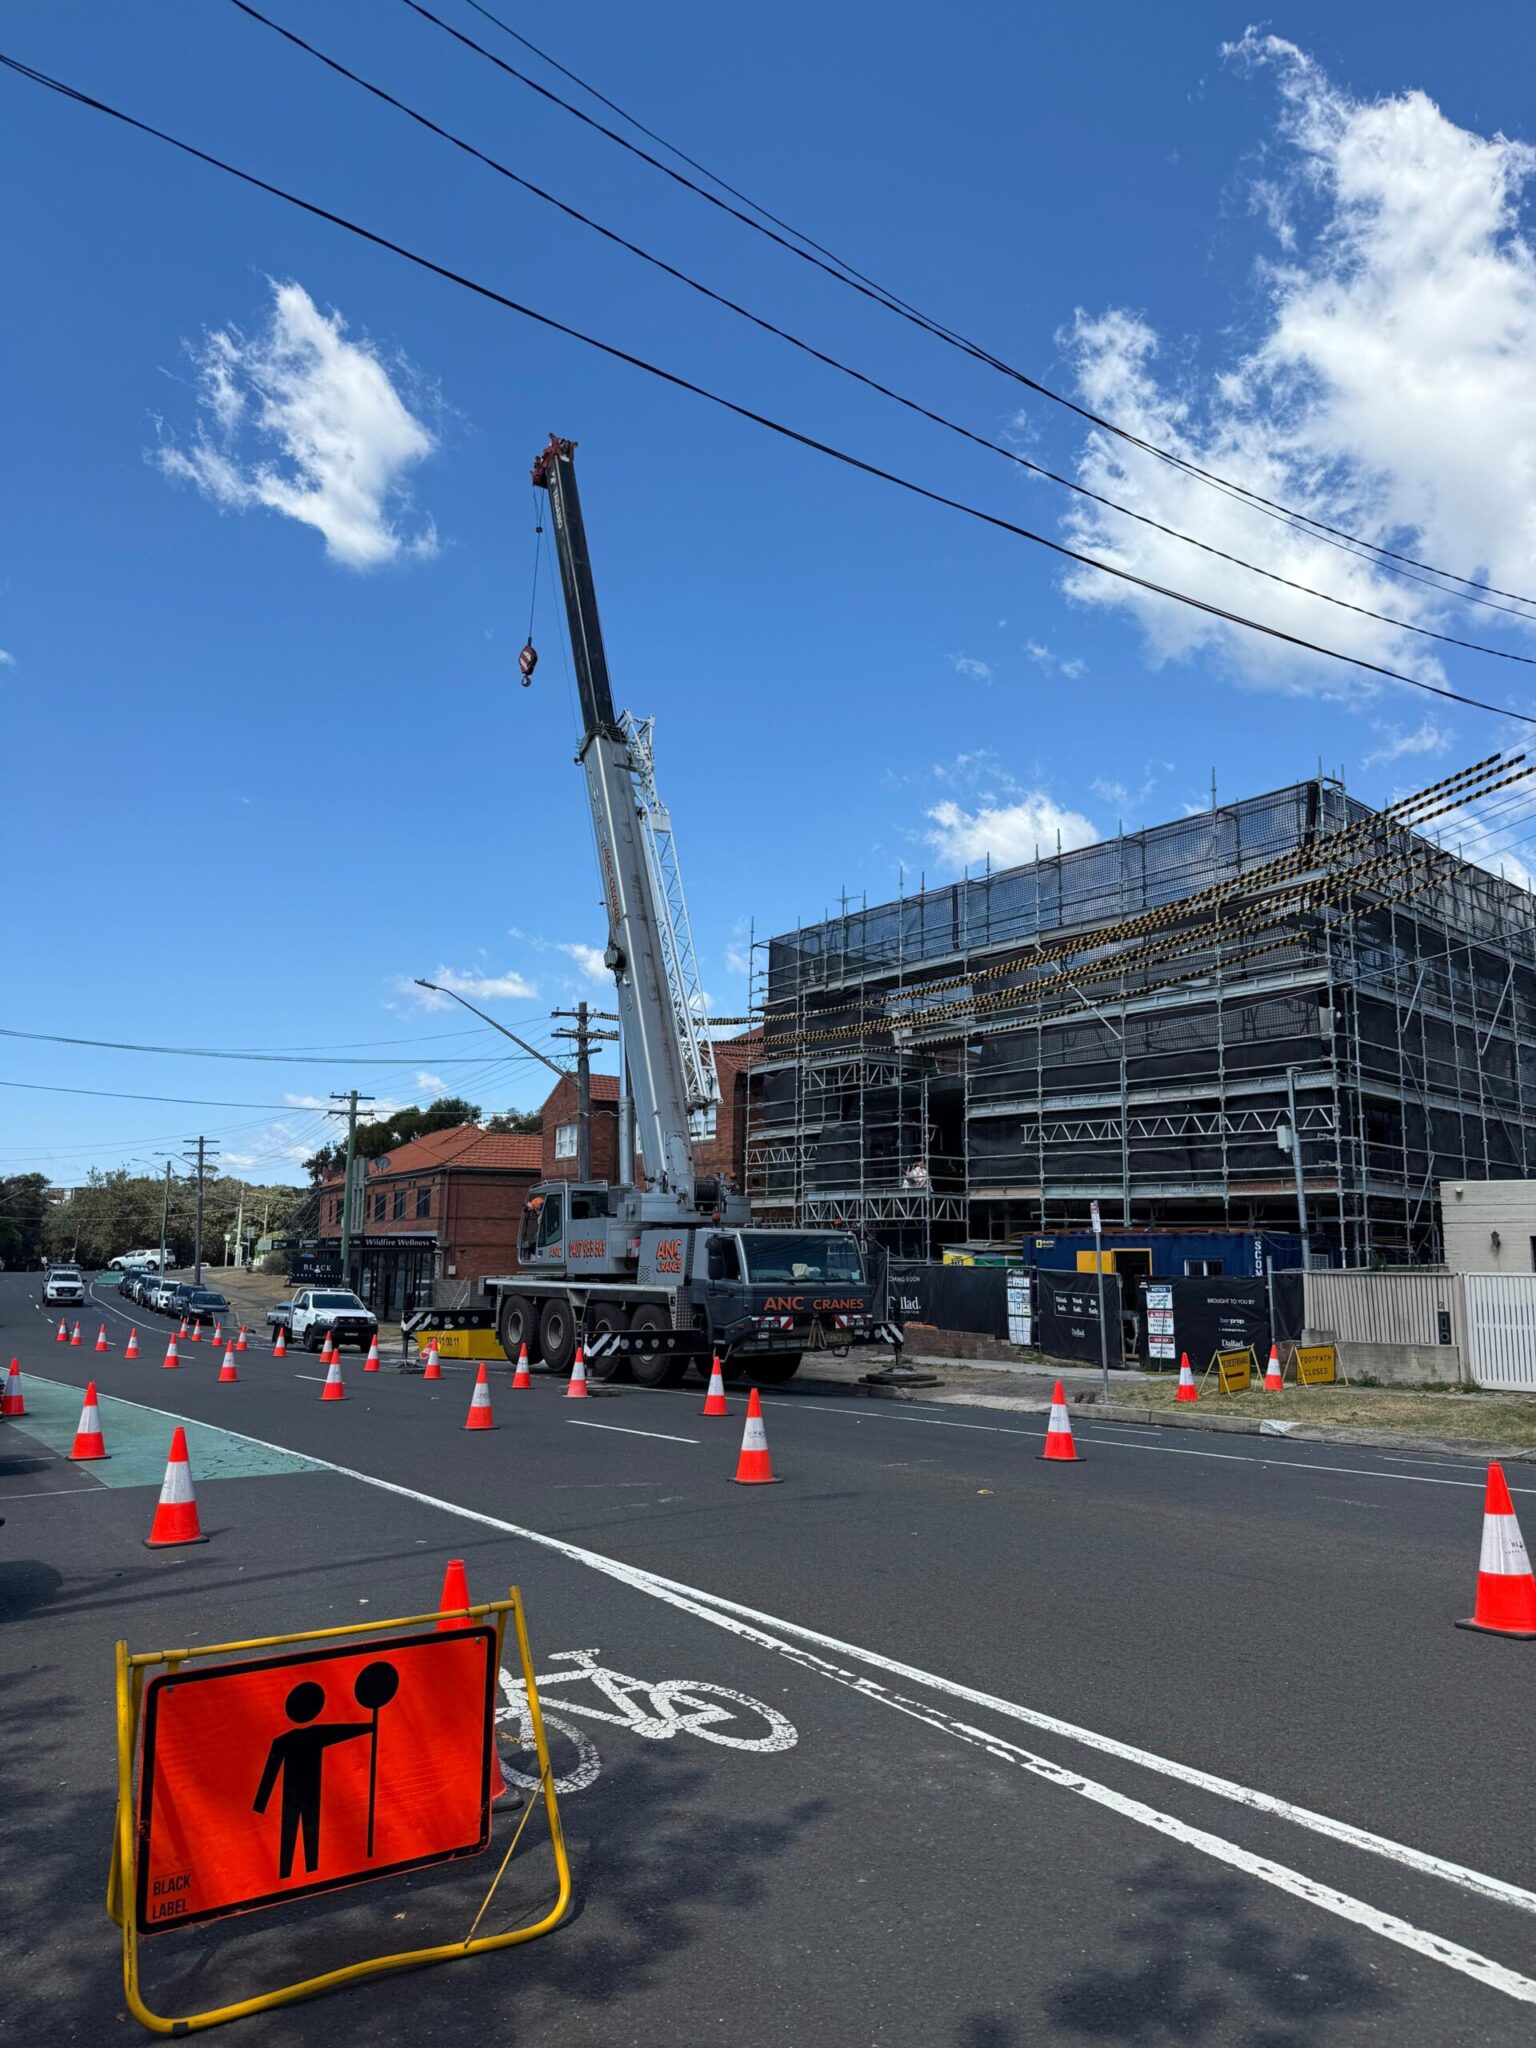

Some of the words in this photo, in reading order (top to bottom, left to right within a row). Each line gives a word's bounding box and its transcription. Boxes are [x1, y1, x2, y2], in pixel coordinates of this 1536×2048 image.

[553, 486, 563, 529] TADANO
[365, 1238, 396, 1246] Wildfire
[397, 1238, 430, 1246] Wellness
[655, 1238, 683, 1261] ANC
[303, 1263, 332, 1271] BLACK
[656, 1261, 682, 1273] CRANES
[763, 1296, 804, 1311] ANC
[812, 1299, 864, 1310] CRANES
[888, 1296, 921, 1310] Dllad.
[1300, 1354, 1332, 1364] FOOTPATH
[1304, 1367, 1328, 1376] CLOSED
[153, 1872, 191, 1896] BLACK
[152, 1898, 188, 1920] LABEL
